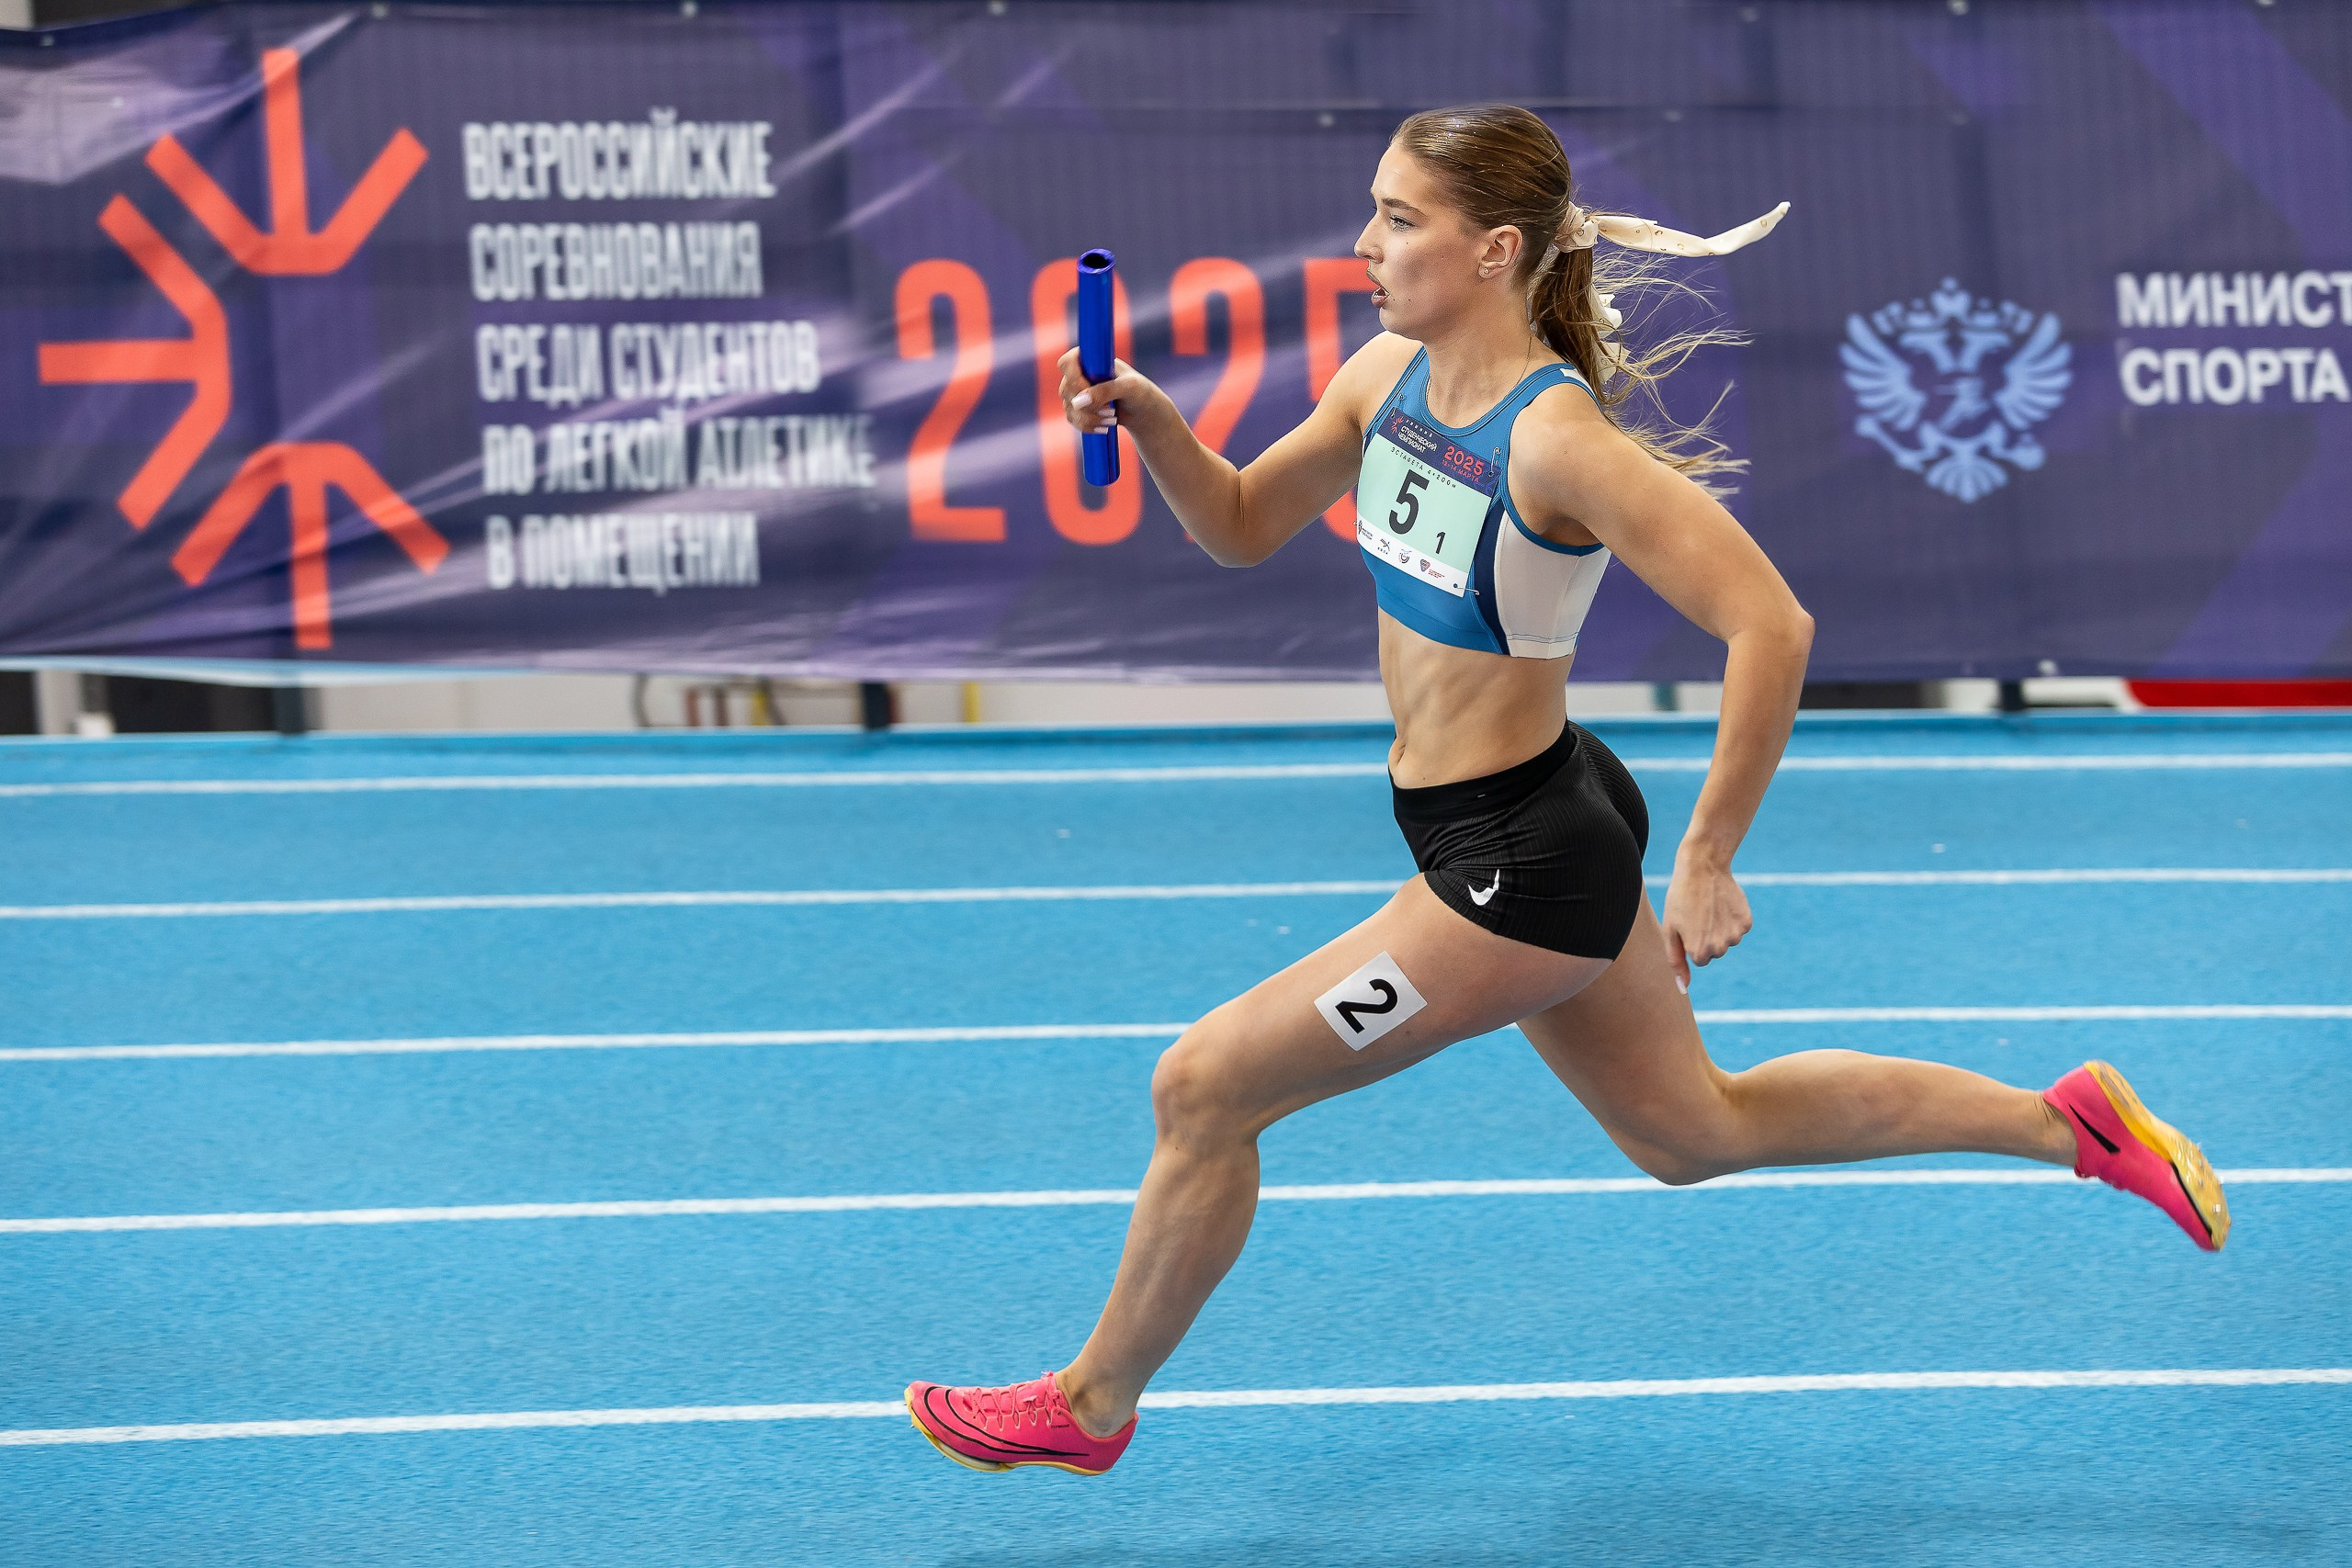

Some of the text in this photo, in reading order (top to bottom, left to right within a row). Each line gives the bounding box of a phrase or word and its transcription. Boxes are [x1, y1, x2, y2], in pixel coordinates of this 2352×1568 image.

[463, 107, 777, 200] ВСЕРОССИЙСКИЕ
[469, 220, 764, 301] СОРЕВНОВАНИЯ
[2116, 270, 2352, 328] МИНИСТ
[476, 320, 820, 408] СРЕДИ СТУДЕНТОВ
[2120, 346, 2351, 406] СПОРТА
[482, 406, 877, 496] ПО ЛЕГКОЙ АТЛЕТИКЕ
[1444, 446, 1484, 475] 2025
[1388, 468, 1430, 535] 5
[486, 510, 762, 598] В ПОМЕЩЕНИИ
[1436, 531, 1446, 555] 1
[1335, 978, 1398, 1034] 2
